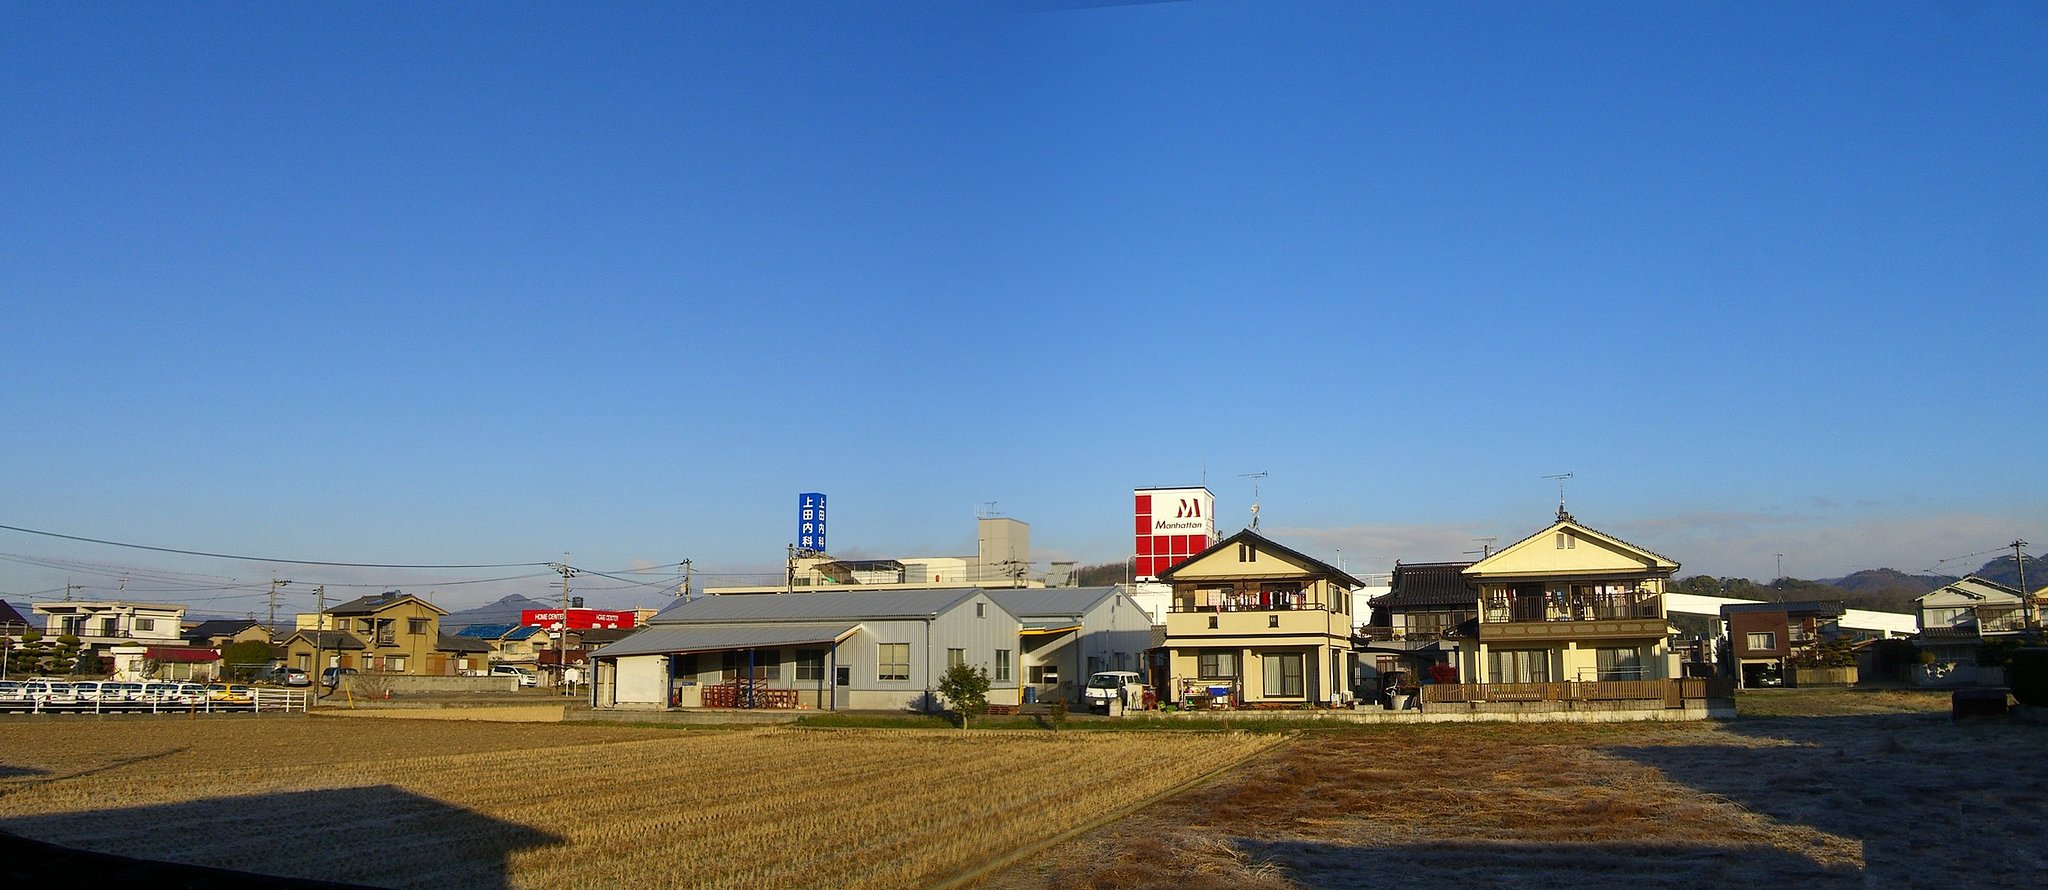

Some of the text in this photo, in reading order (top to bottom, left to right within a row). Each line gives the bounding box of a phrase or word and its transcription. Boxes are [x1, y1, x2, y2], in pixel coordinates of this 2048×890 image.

[802, 496, 813, 547] 上田内科
[1155, 520, 1203, 530] Manhattan
